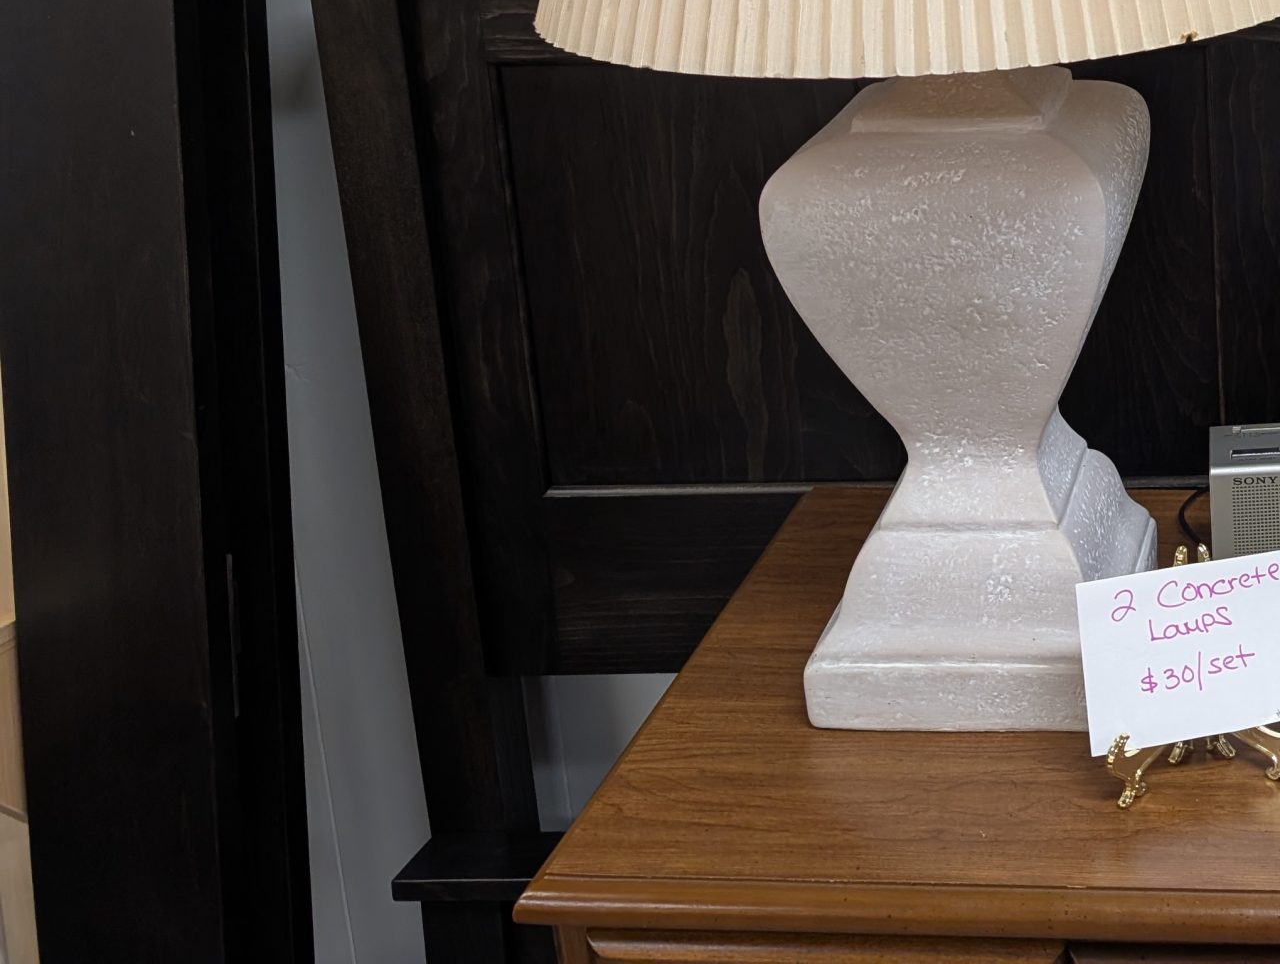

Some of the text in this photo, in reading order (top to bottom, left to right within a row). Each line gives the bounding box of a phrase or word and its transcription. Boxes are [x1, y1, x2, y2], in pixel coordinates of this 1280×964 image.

[1233, 476, 1278, 486] SONY
[1111, 563, 1280, 622] 2 Concrete
[1140, 644, 1255, 694] $30/set
